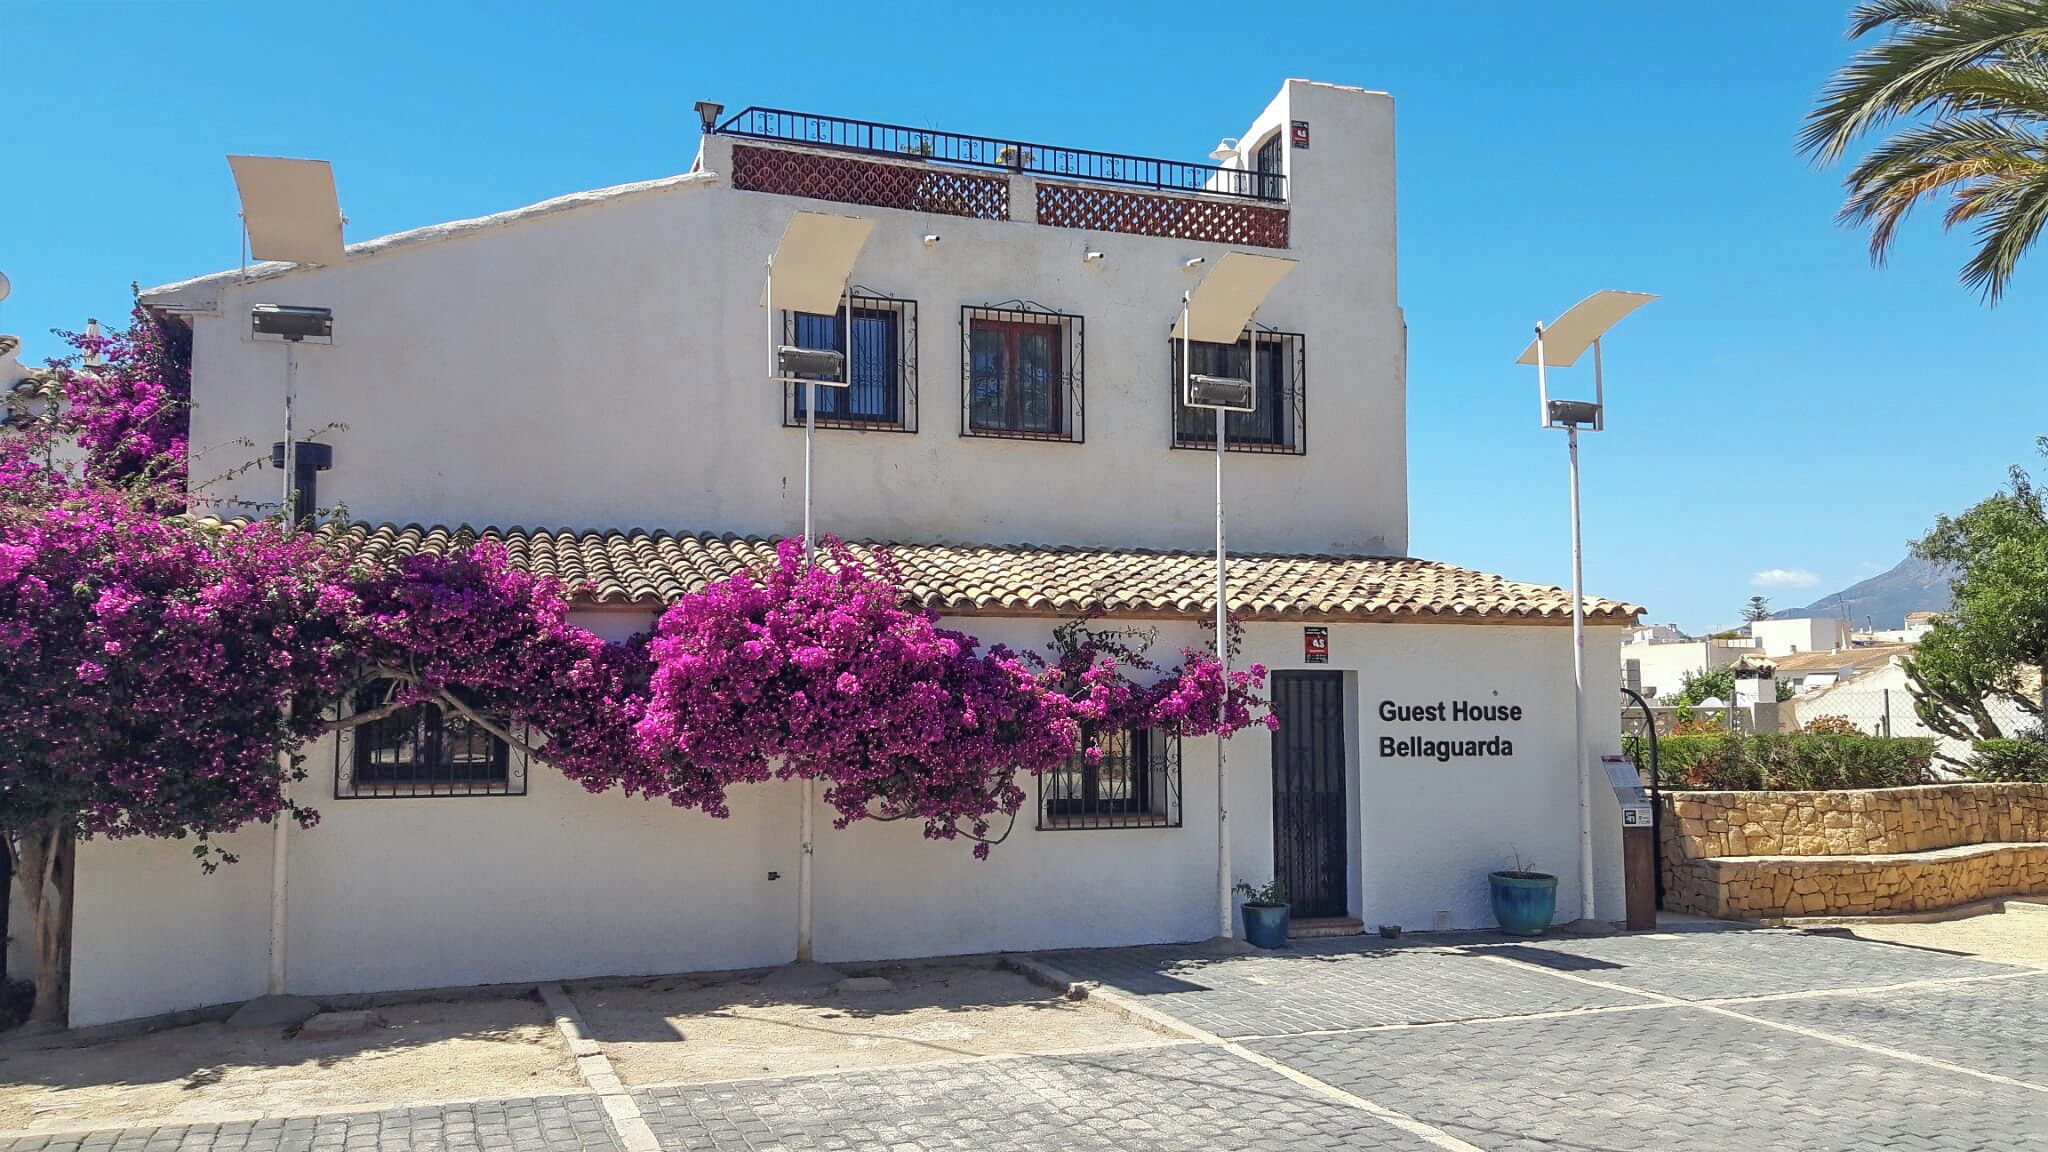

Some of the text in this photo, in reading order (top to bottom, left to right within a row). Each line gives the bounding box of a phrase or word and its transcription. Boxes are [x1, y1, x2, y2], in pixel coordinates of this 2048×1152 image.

[1378, 700, 1523, 722] Guest House
[1379, 735, 1514, 763] Bellaguarda
